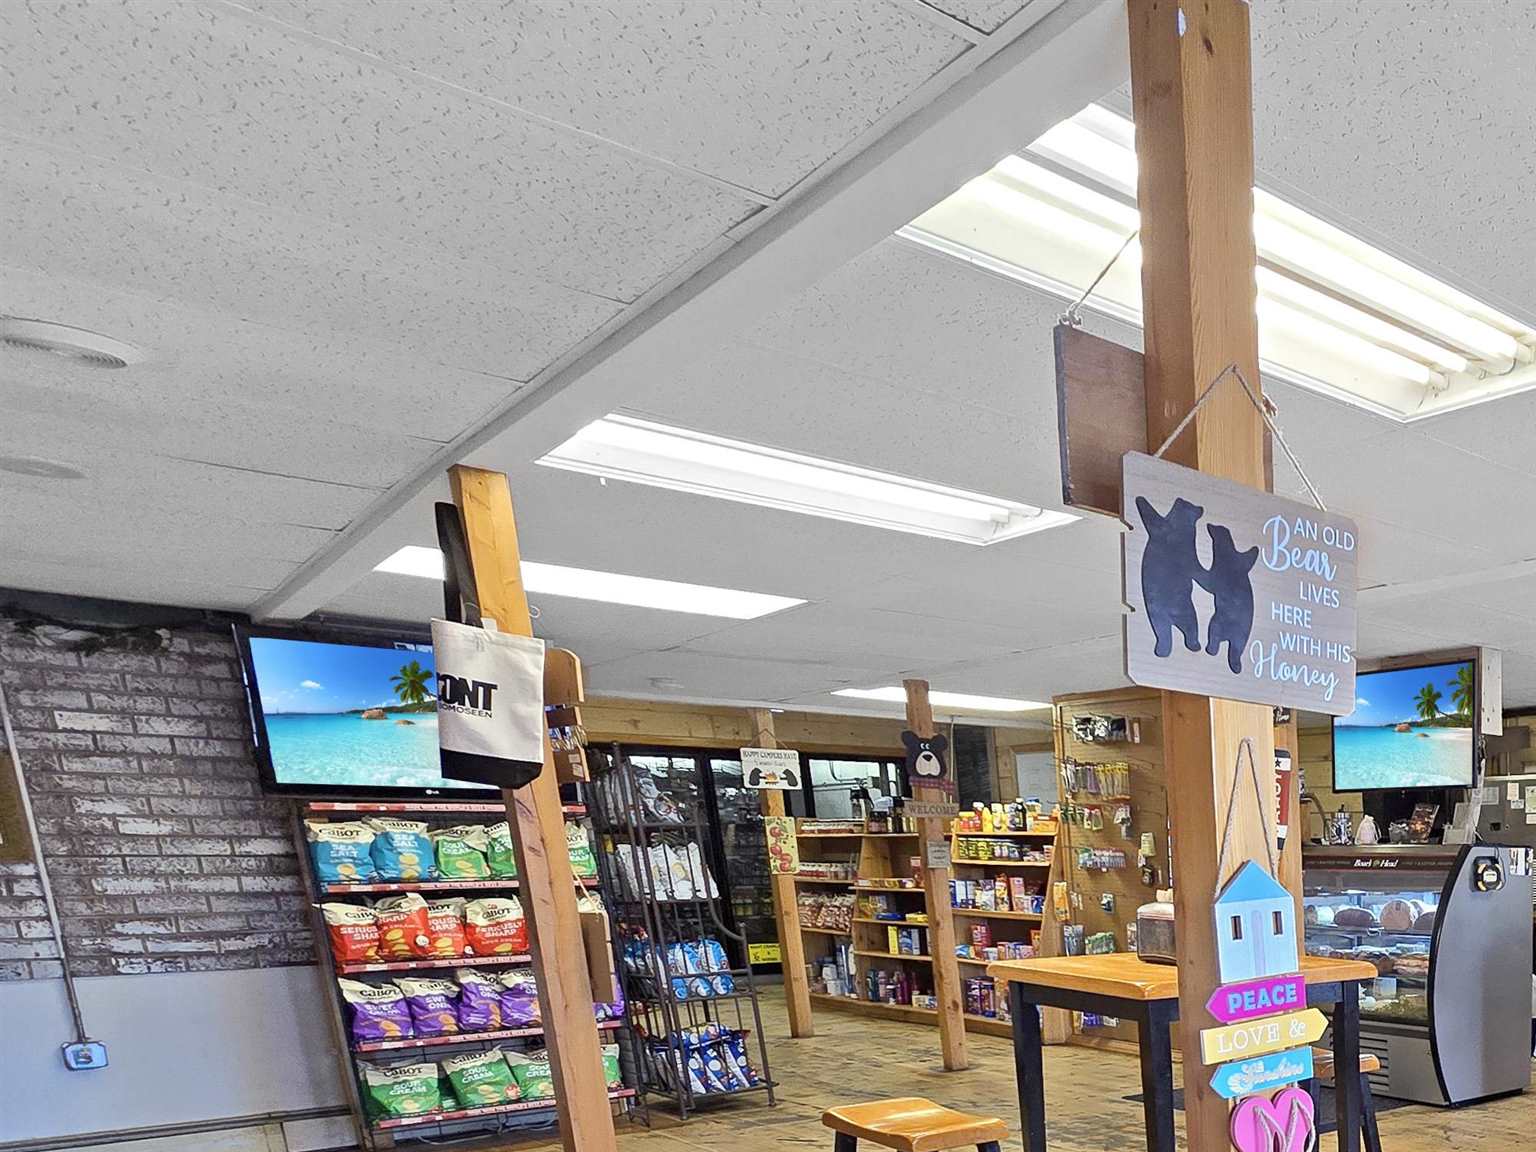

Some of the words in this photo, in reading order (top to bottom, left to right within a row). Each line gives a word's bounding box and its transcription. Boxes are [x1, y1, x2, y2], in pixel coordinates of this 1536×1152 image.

[1261, 514, 1338, 582] Bear
[1293, 517, 1318, 541] AN
[1322, 526, 1355, 551] OLD
[1299, 581, 1340, 609] LIVES
[1271, 601, 1312, 628] HERE
[1279, 631, 1321, 657] WITH
[1326, 641, 1352, 664] HIS
[1249, 639, 1340, 702] Honey
[440, 703, 493, 718] OMOSEEN
[910, 804, 956, 815] WELCOME
[1227, 983, 1297, 1015] PEACE
[1216, 1022, 1280, 1054] LOVE
[1288, 1017, 1306, 1039] &
